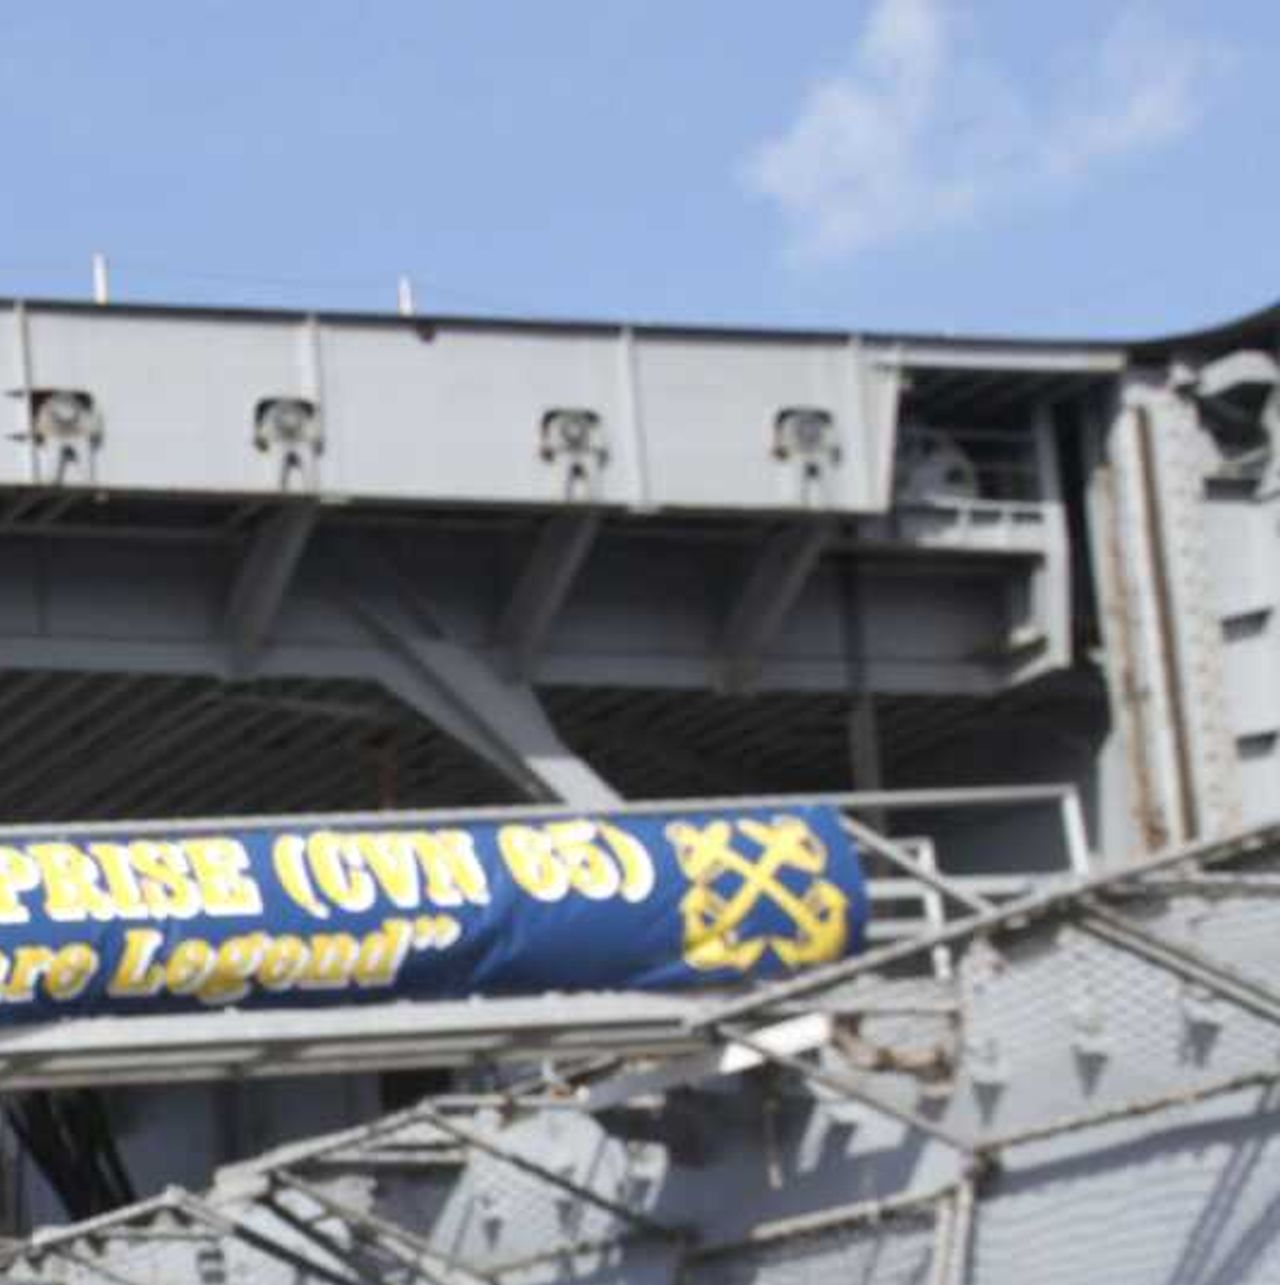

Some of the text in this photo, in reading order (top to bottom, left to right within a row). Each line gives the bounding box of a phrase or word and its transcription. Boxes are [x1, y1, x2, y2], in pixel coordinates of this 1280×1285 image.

[272, 829, 491, 919] (CVN
[497, 820, 656, 903] 65)
[107, 914, 462, 1005] Legend”
